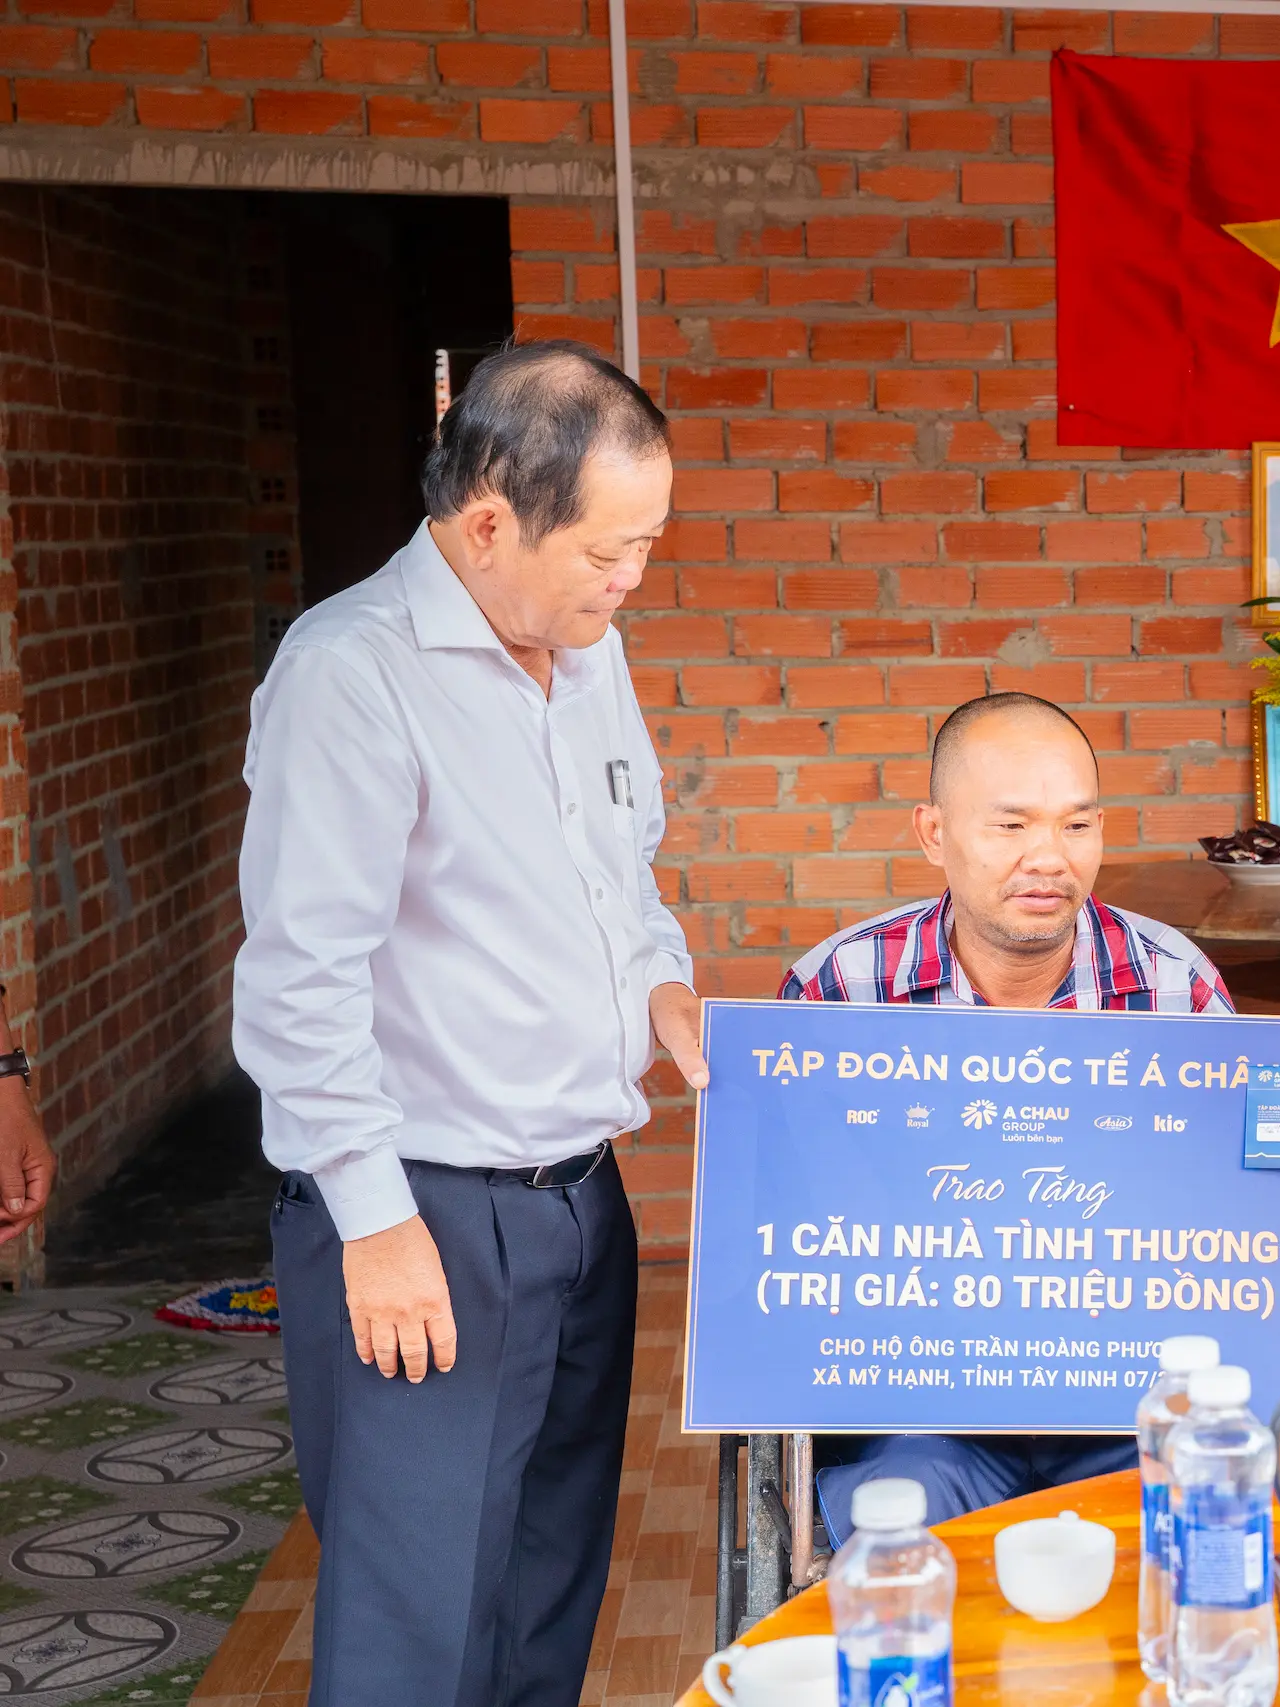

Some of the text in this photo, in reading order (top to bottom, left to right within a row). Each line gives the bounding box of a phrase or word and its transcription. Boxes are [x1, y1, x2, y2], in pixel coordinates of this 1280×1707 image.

[752, 1042, 1250, 1089] TẬP ĐOÀN QUỐC TẾ Á CHÂ
[846, 1109, 878, 1124] ROC
[1002, 1106, 1070, 1121] A CHAU
[1099, 1116, 1127, 1128] Asia
[907, 1119, 929, 1129] Royal
[1002, 1122, 1045, 1132] GROUP
[1154, 1114, 1186, 1132] kio
[1002, 1134, 1063, 1144] Luôn bên bạn
[926, 1163, 1114, 1220] Trao Tặng
[756, 1215, 1279, 1264] 1 CĂN NHÀ TÌNH THƯƠNG
[756, 1265, 1275, 1321] (TRỊ GIÁ: 80 TRIỆU ĐỒNG)
[819, 1335, 1163, 1360] CHO HỘ ÔNG TRẦN HOÀNG PHƯƠ
[812, 1364, 842, 1385] XÃ
[848, 1364, 882, 1386] MỸ
[888, 1368, 955, 1390] HẠNH,
[962, 1364, 1013, 1387] TỈNH
[1019, 1365, 1059, 1387] TÂY
[1065, 1370, 1117, 1387] NINH
